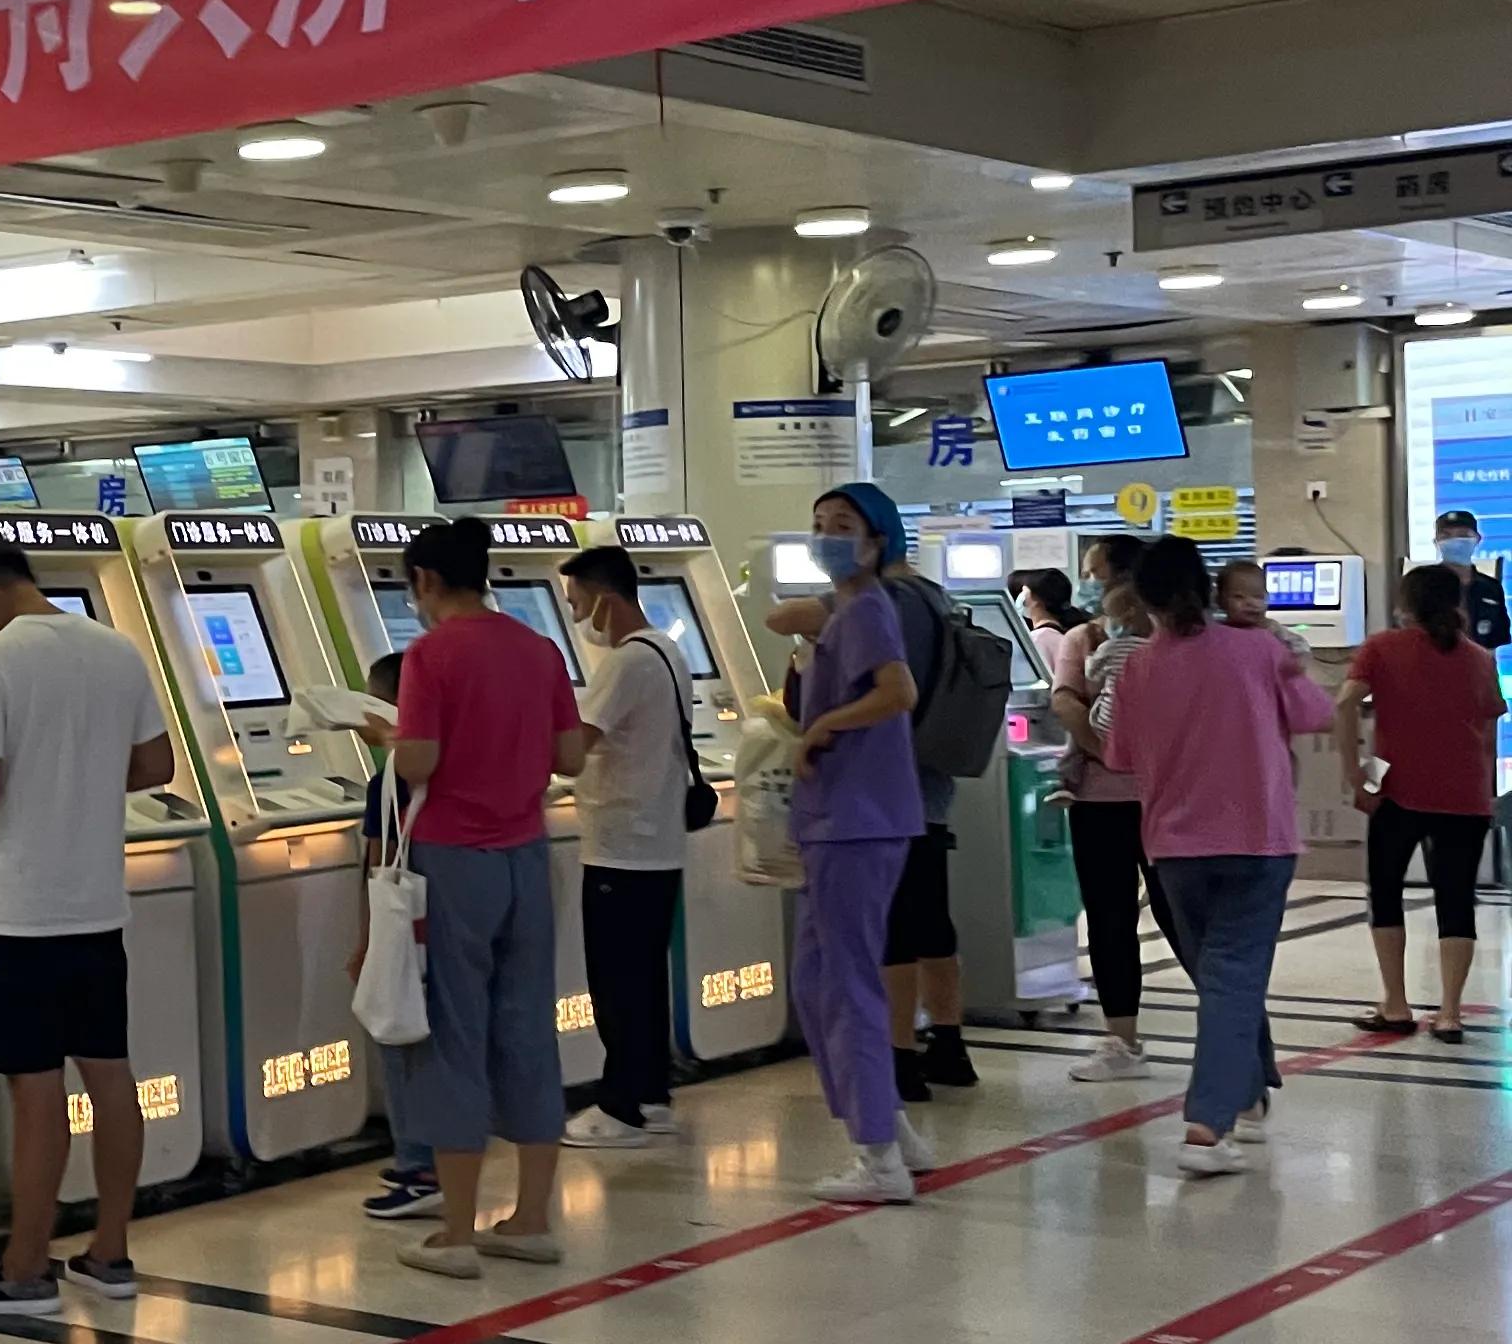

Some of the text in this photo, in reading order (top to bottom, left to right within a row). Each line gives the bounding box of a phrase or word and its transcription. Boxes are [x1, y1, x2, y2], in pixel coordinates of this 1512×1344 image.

[170, 520, 275, 544] 门诊服务一体机
